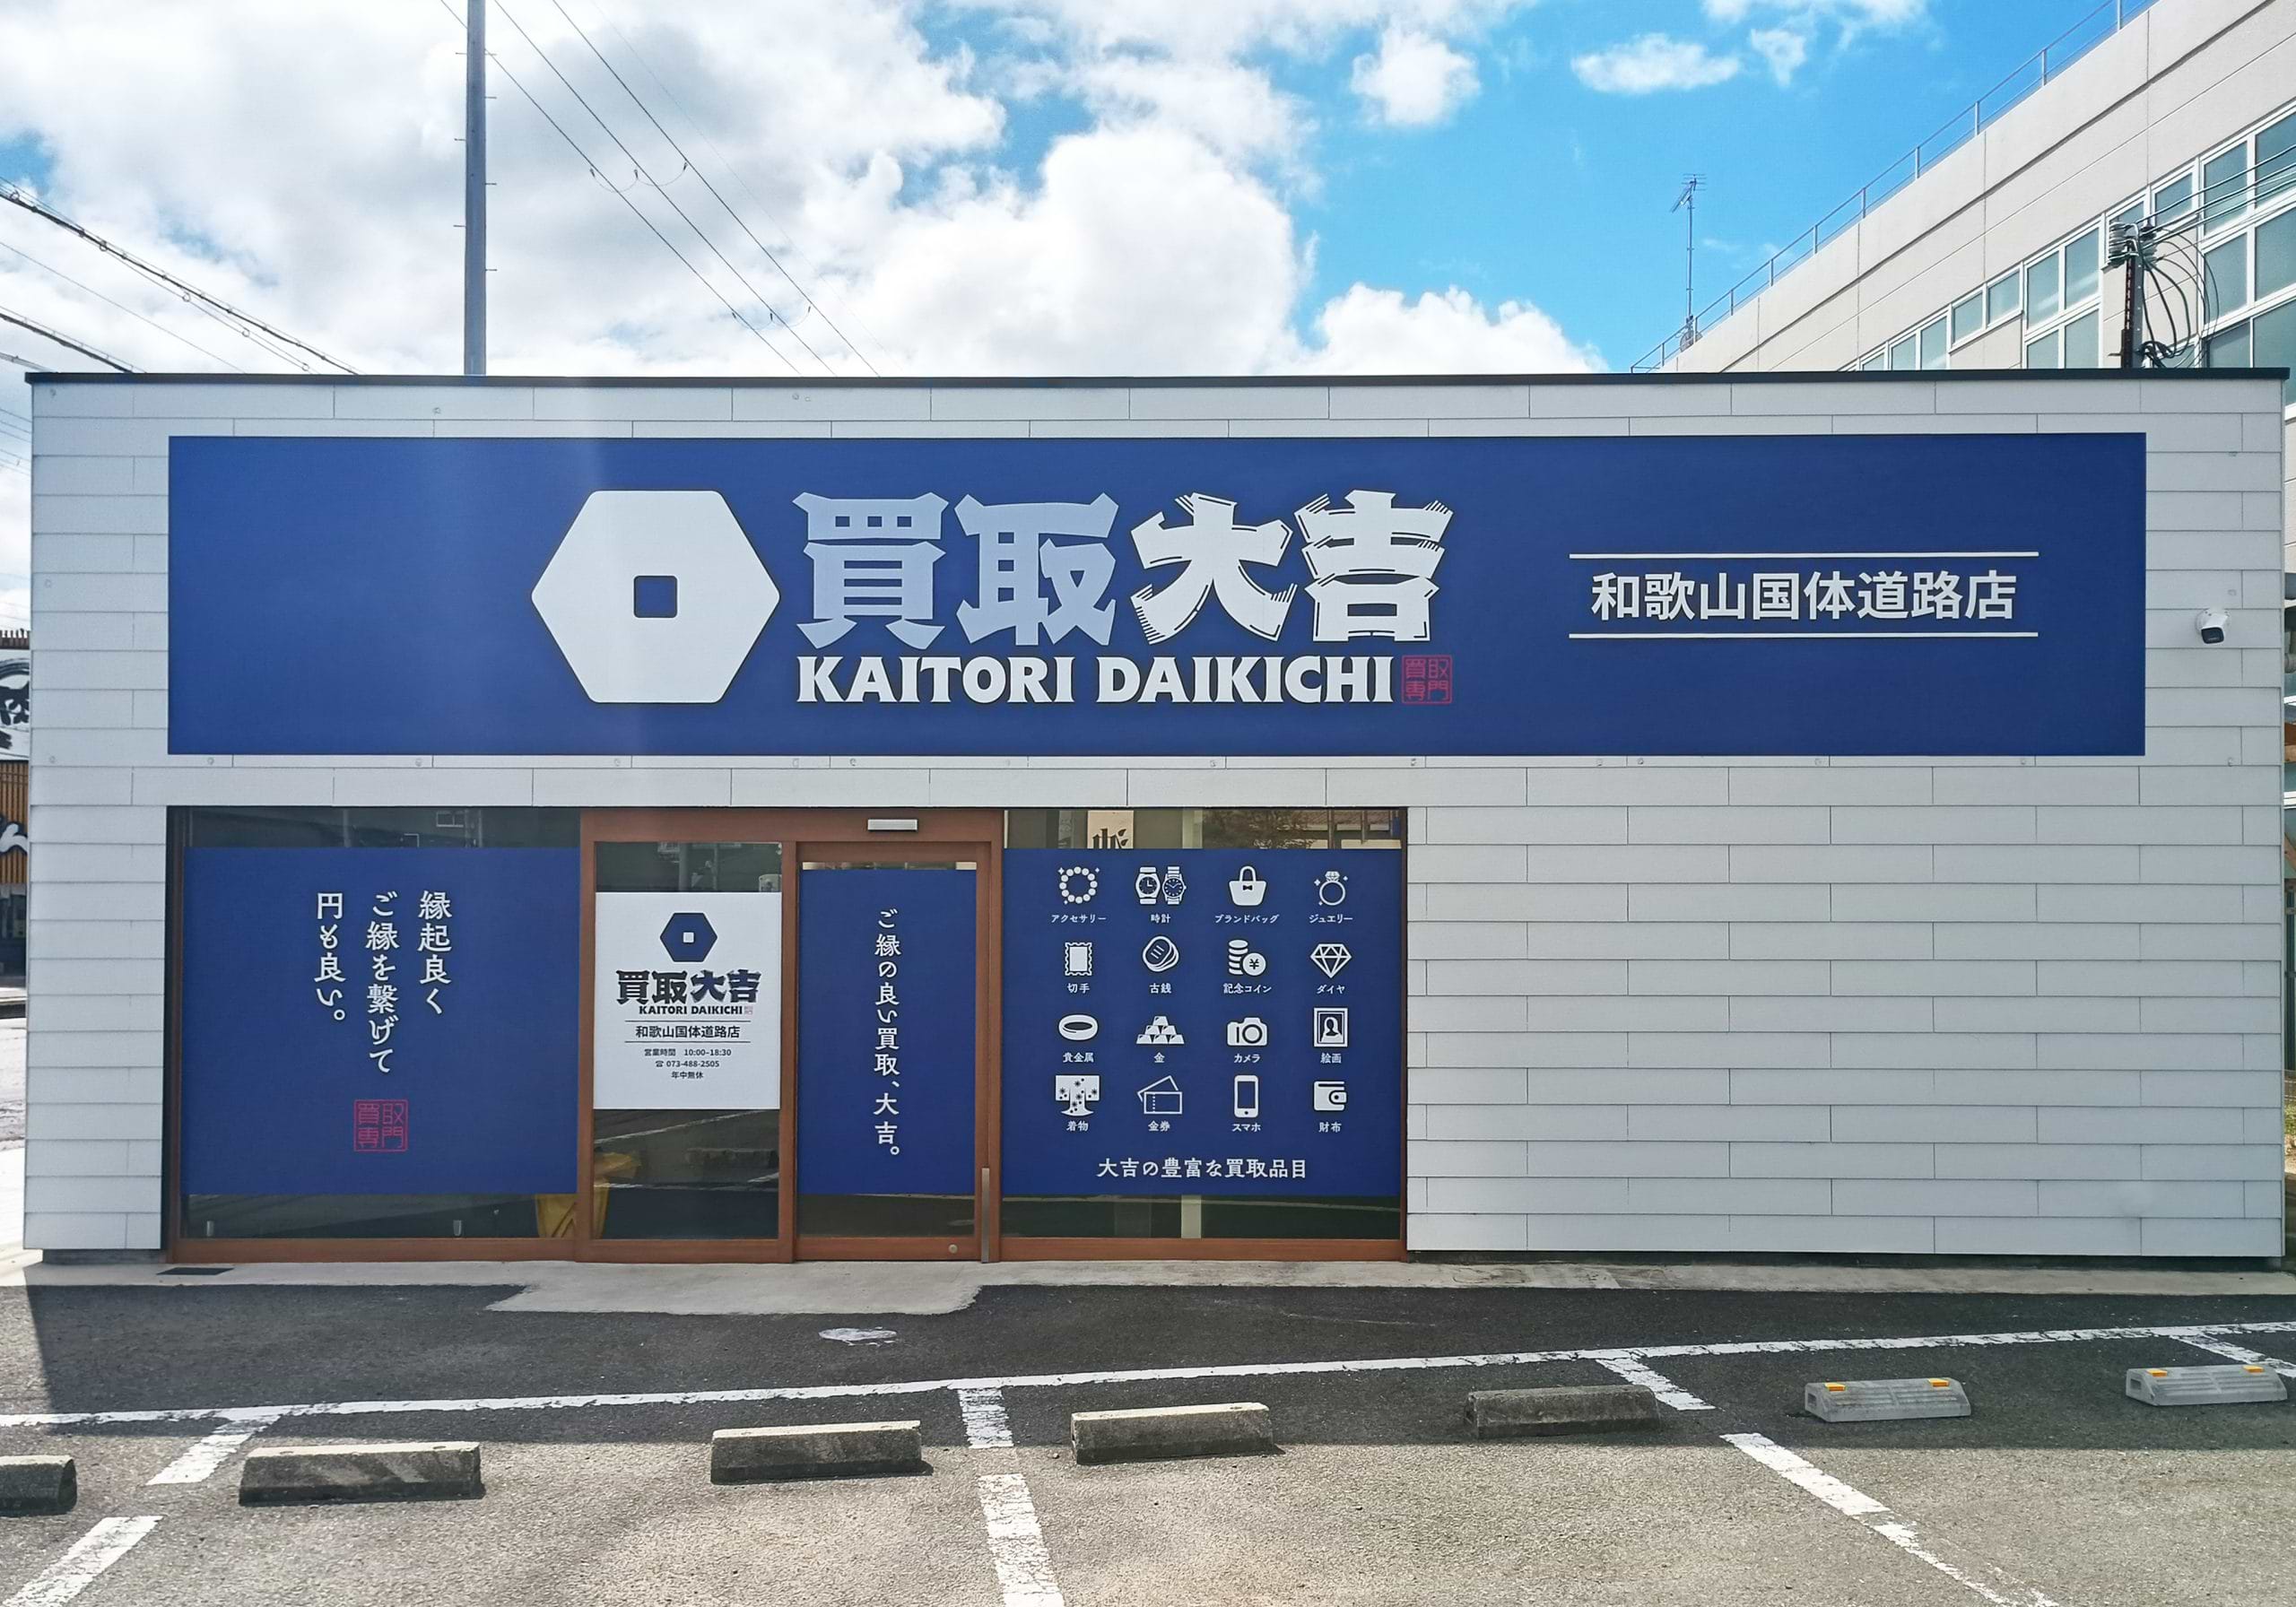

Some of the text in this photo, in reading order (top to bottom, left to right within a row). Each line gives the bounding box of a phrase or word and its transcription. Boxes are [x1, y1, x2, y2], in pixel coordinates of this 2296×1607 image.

[791, 489, 1454, 648] 買取大吉
[1591, 569, 2017, 621] 和歌山国体道路店
[796, 656, 1394, 704] KAITORI DAIKICHI
[1051, 914, 1107, 924] アクセサリー
[1150, 913, 1171, 924] 時計
[1214, 914, 1280, 924] ブランドバッグ
[1309, 913, 1353, 924] ジュエリー
[314, 892, 346, 1021] 円も良い。
[417, 890, 453, 1014] 縁起良く
[365, 890, 400, 1073] ご縁を繋げて
[615, 969, 761, 1005] 買取大吉
[1066, 982, 1091, 994] 切手
[1149, 982, 1172, 994] 古銭
[1222, 982, 1272, 995] 記念コイン
[1317, 984, 1345, 995] ダイヤ
[639, 1005, 688, 1015] KAITORI
[691, 1005, 743, 1015] DAIKICHI
[635, 1025, 741, 1038] 和歌山国体道路店
[873, 908, 901, 1155] ご縁の良い買取、大吉。
[644, 1047, 676, 1056] 営業時間
[1062, 1052, 1094, 1063] 貴金属
[665, 1060, 720, 1068] 073-488-2505
[1153, 1052, 1165, 1064] 金
[1233, 1053, 1261, 1064] カメラ
[1320, 1052, 1342, 1064] 絵画
[671, 1071, 704, 1080] 年中無休
[1065, 1120, 1089, 1132] 着物
[1147, 1120, 1170, 1132] 金券
[1231, 1122, 1261, 1133] スマホ
[1318, 1121, 1342, 1134] 財布
[1097, 1157, 1306, 1178] 大吉の豊富な買取品目
